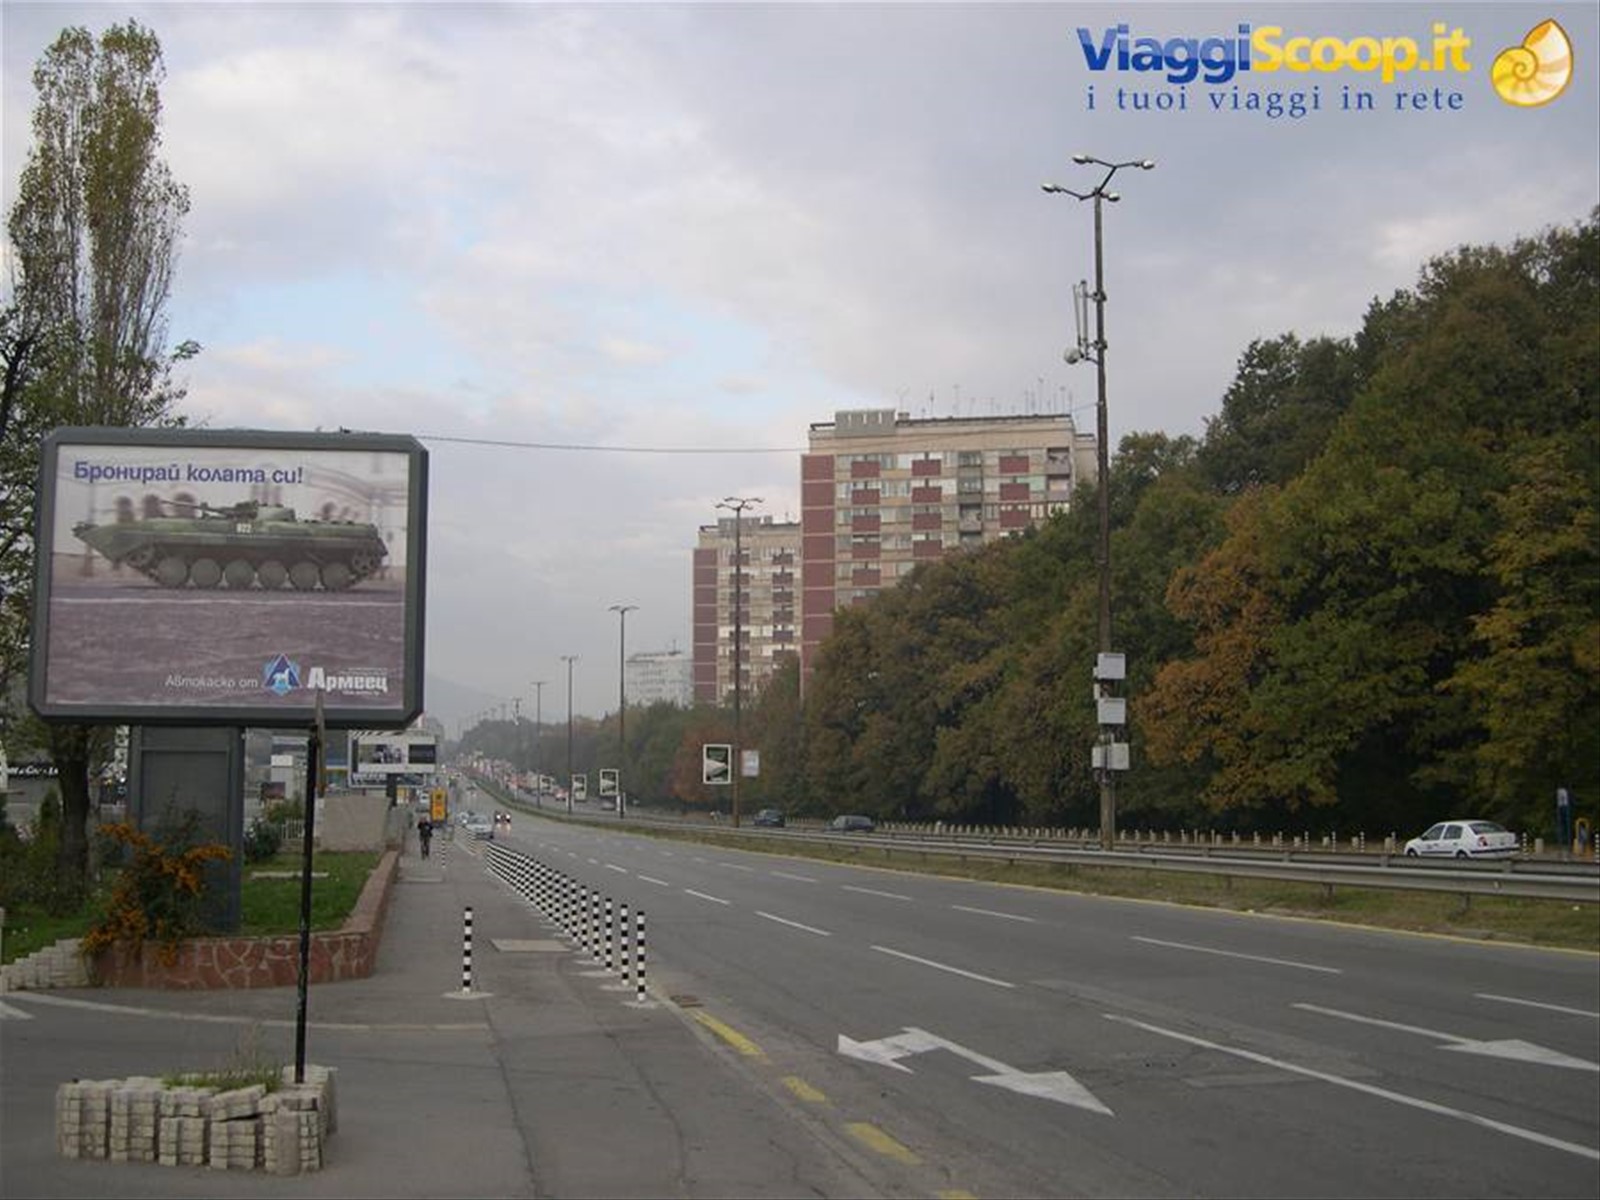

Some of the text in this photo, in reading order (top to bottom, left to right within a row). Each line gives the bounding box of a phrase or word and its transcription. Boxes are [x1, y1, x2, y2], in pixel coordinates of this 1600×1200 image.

[74, 461, 304, 484] Бронирай колата си!
